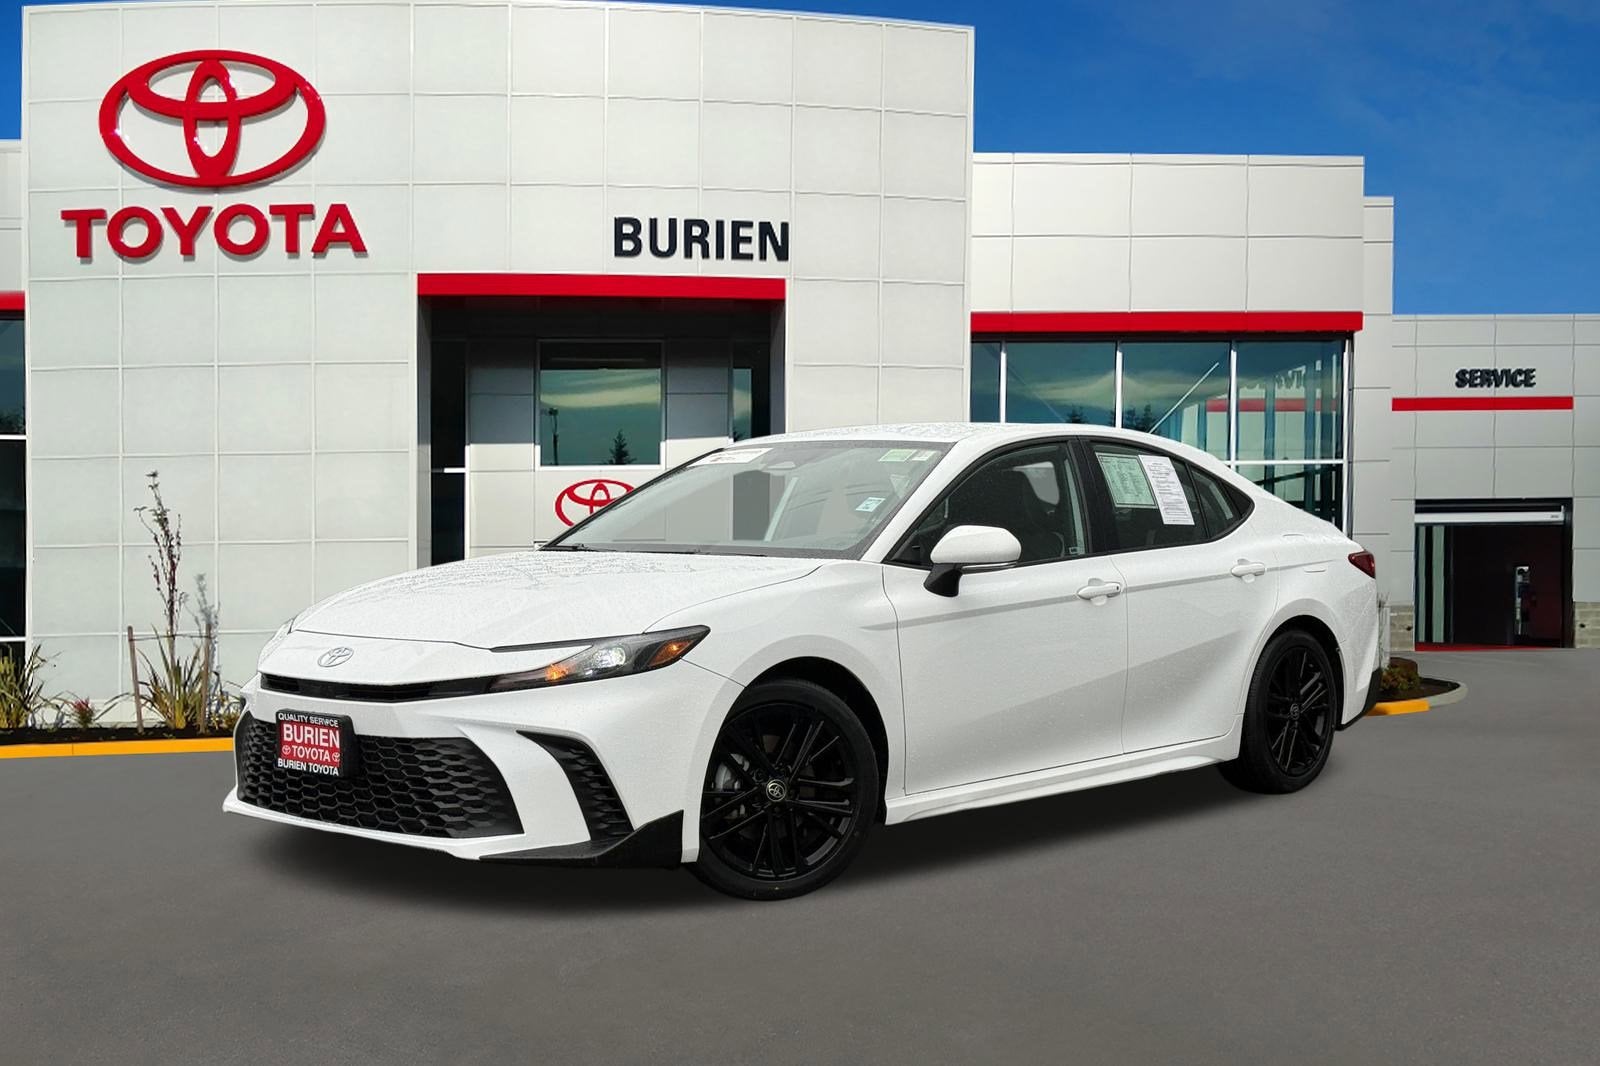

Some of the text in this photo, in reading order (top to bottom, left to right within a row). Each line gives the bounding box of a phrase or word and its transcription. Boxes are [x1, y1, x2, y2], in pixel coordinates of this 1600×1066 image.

[61, 203, 368, 259] TOYOTA
[614, 216, 790, 262] BURIEN
[1455, 368, 1537, 388] SERVICE
[278, 712, 308, 723] QUALITY
[283, 723, 340, 748] BURIEN
[292, 745, 331, 762] TOYOTA
[277, 758, 339, 776] BURIEN TOYOTA
